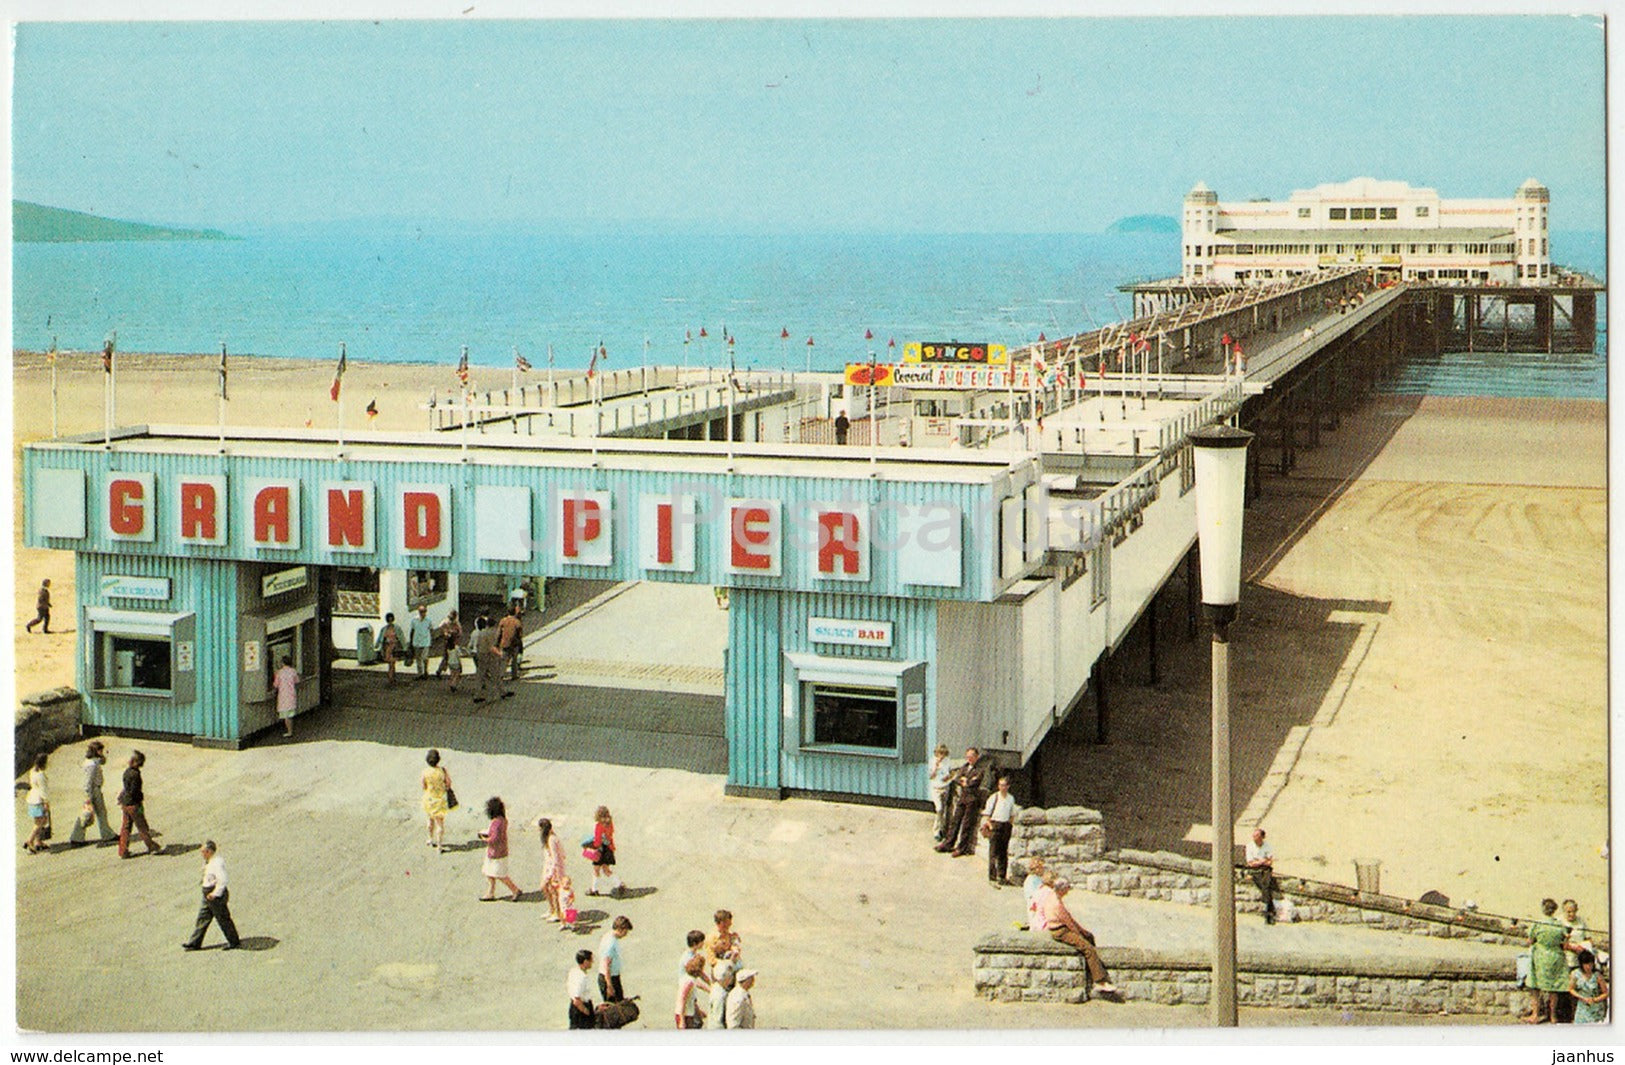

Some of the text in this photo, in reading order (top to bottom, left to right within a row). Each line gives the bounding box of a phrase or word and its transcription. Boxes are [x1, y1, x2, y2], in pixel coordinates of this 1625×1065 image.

[923, 345, 984, 361] BINGO
[894, 368, 934, 384] Covered
[108, 478, 862, 575] GRAND PIER
[858, 629, 885, 640] BAR
